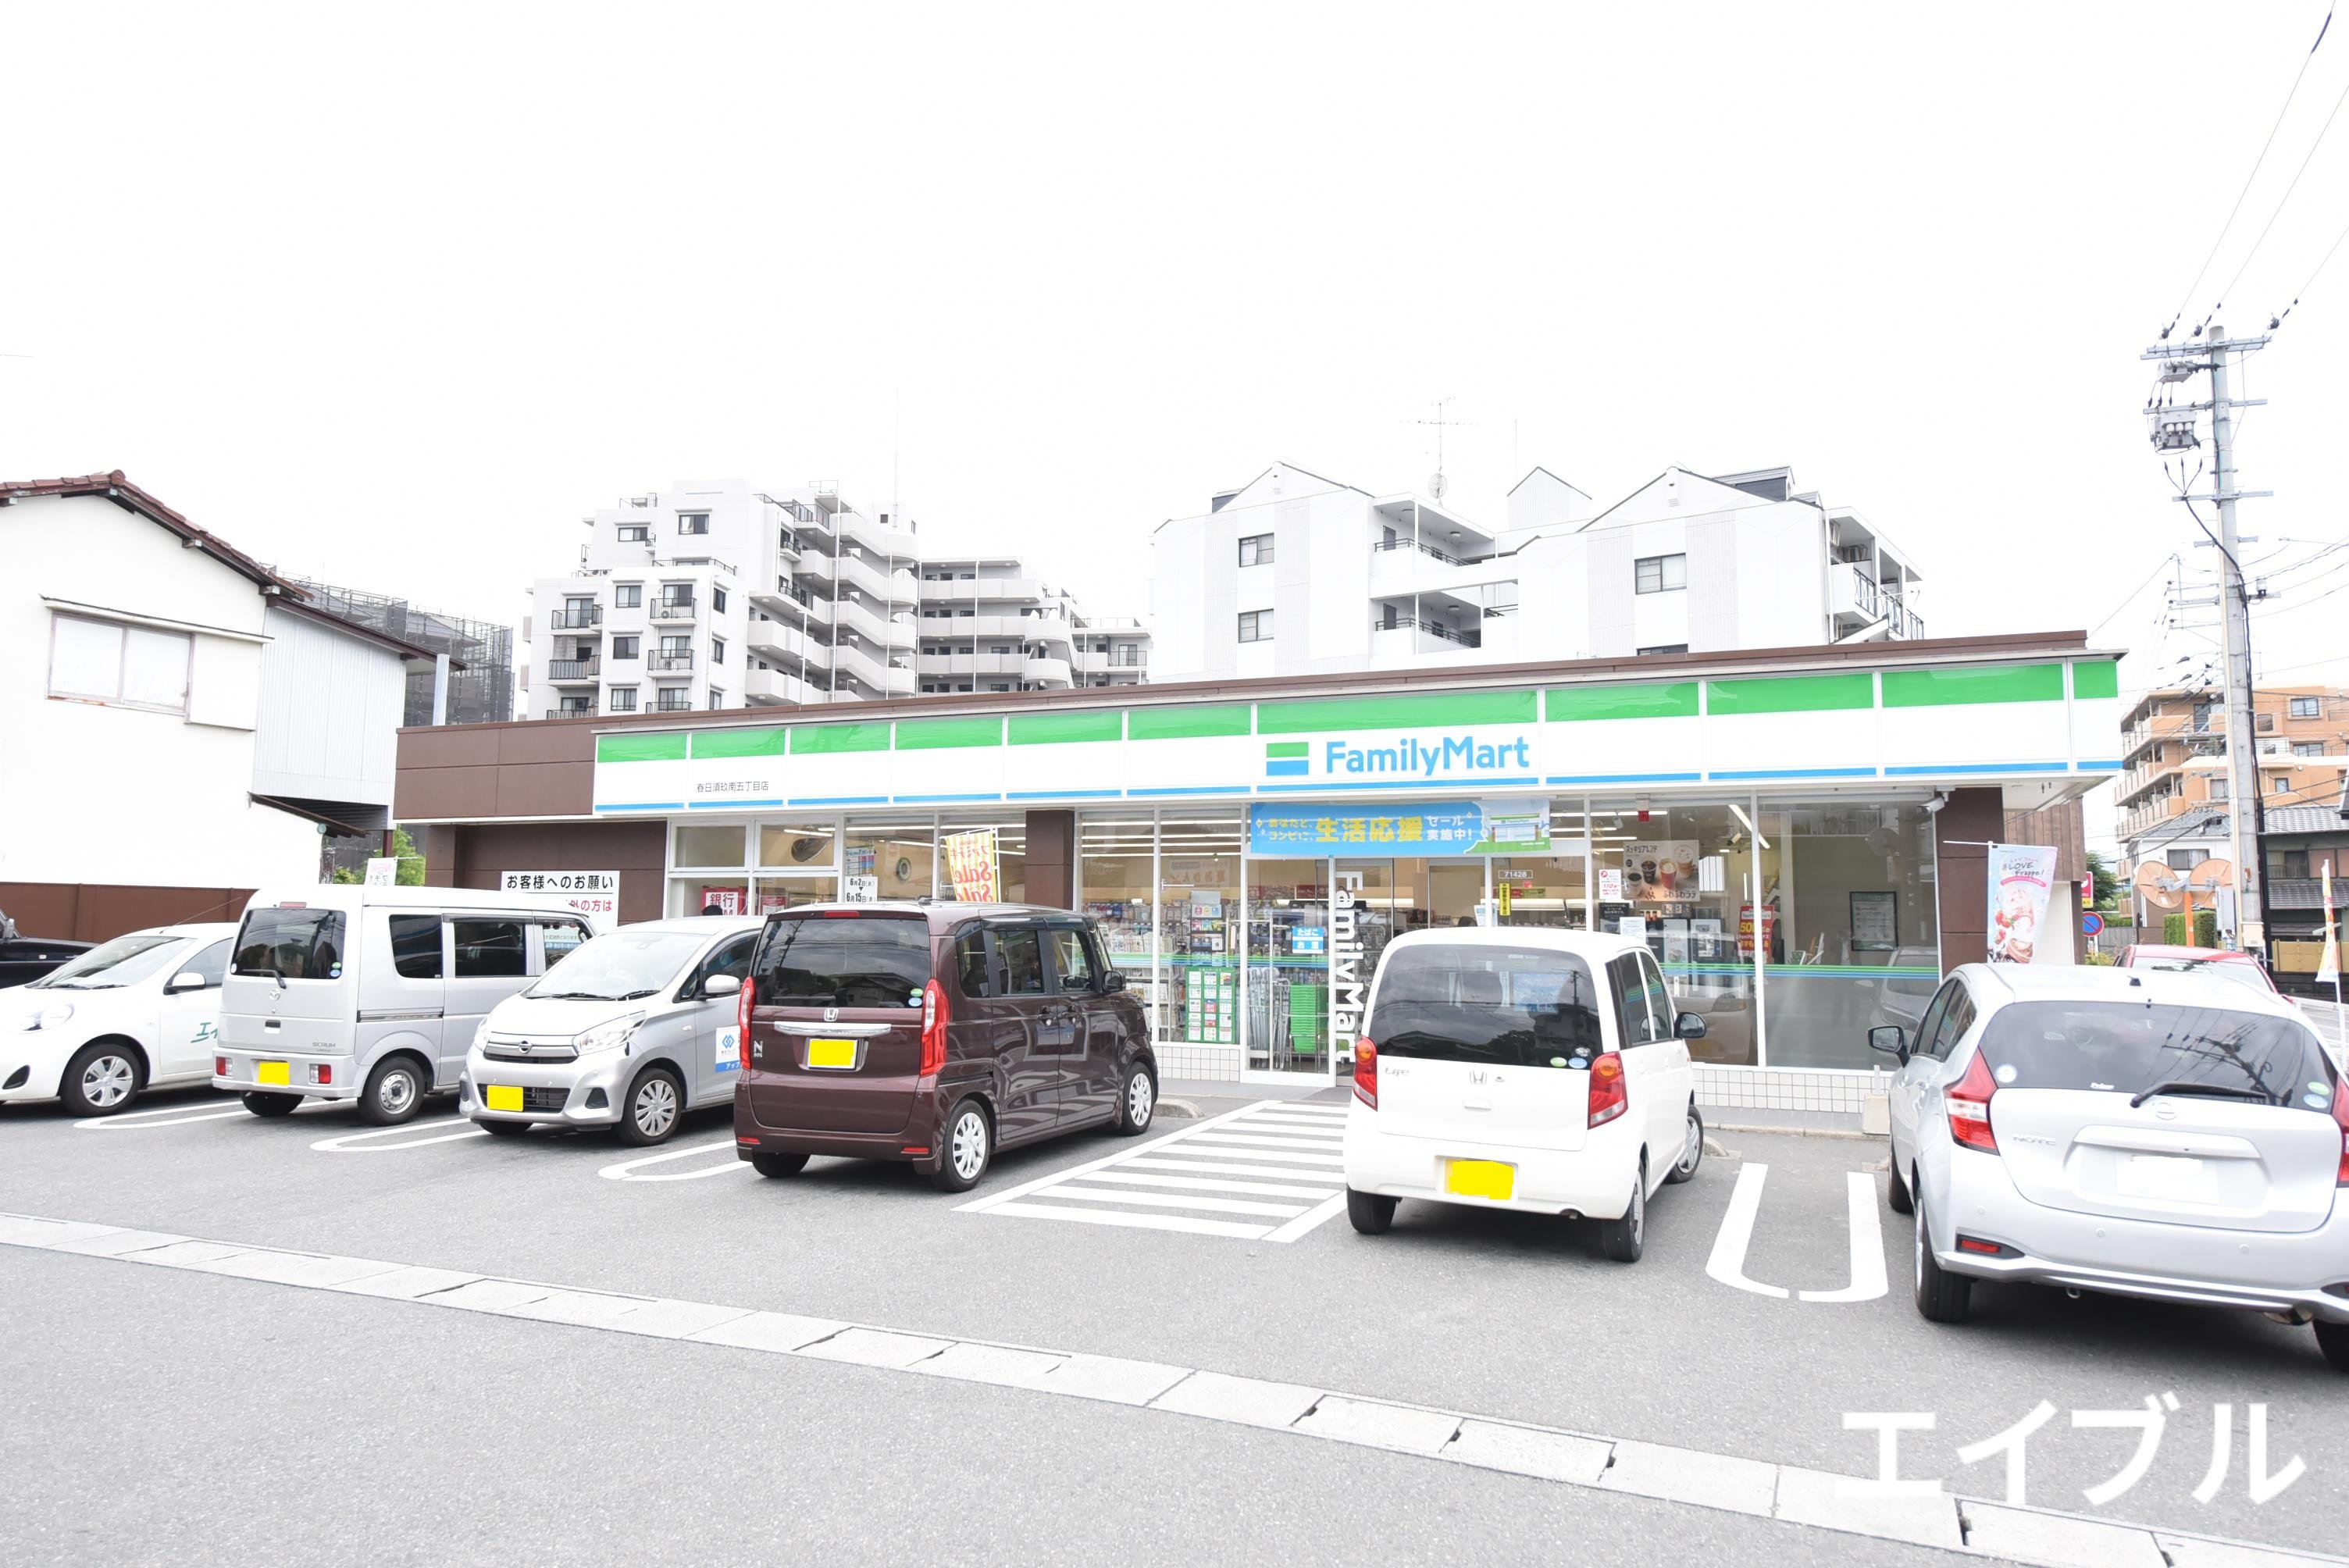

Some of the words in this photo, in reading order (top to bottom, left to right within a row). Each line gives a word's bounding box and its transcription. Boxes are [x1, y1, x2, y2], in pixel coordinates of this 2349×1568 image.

[1326, 736, 1530, 776] FamilyMart
[697, 781, 769, 793] 春日須玖南五丁目店
[1427, 814, 1464, 827] セール
[1315, 816, 1423, 843] 生活応援
[507, 875, 615, 890] お客様へのお願い
[710, 893, 735, 907] 銀行
[1336, 871, 1364, 1064] FamilyMart
